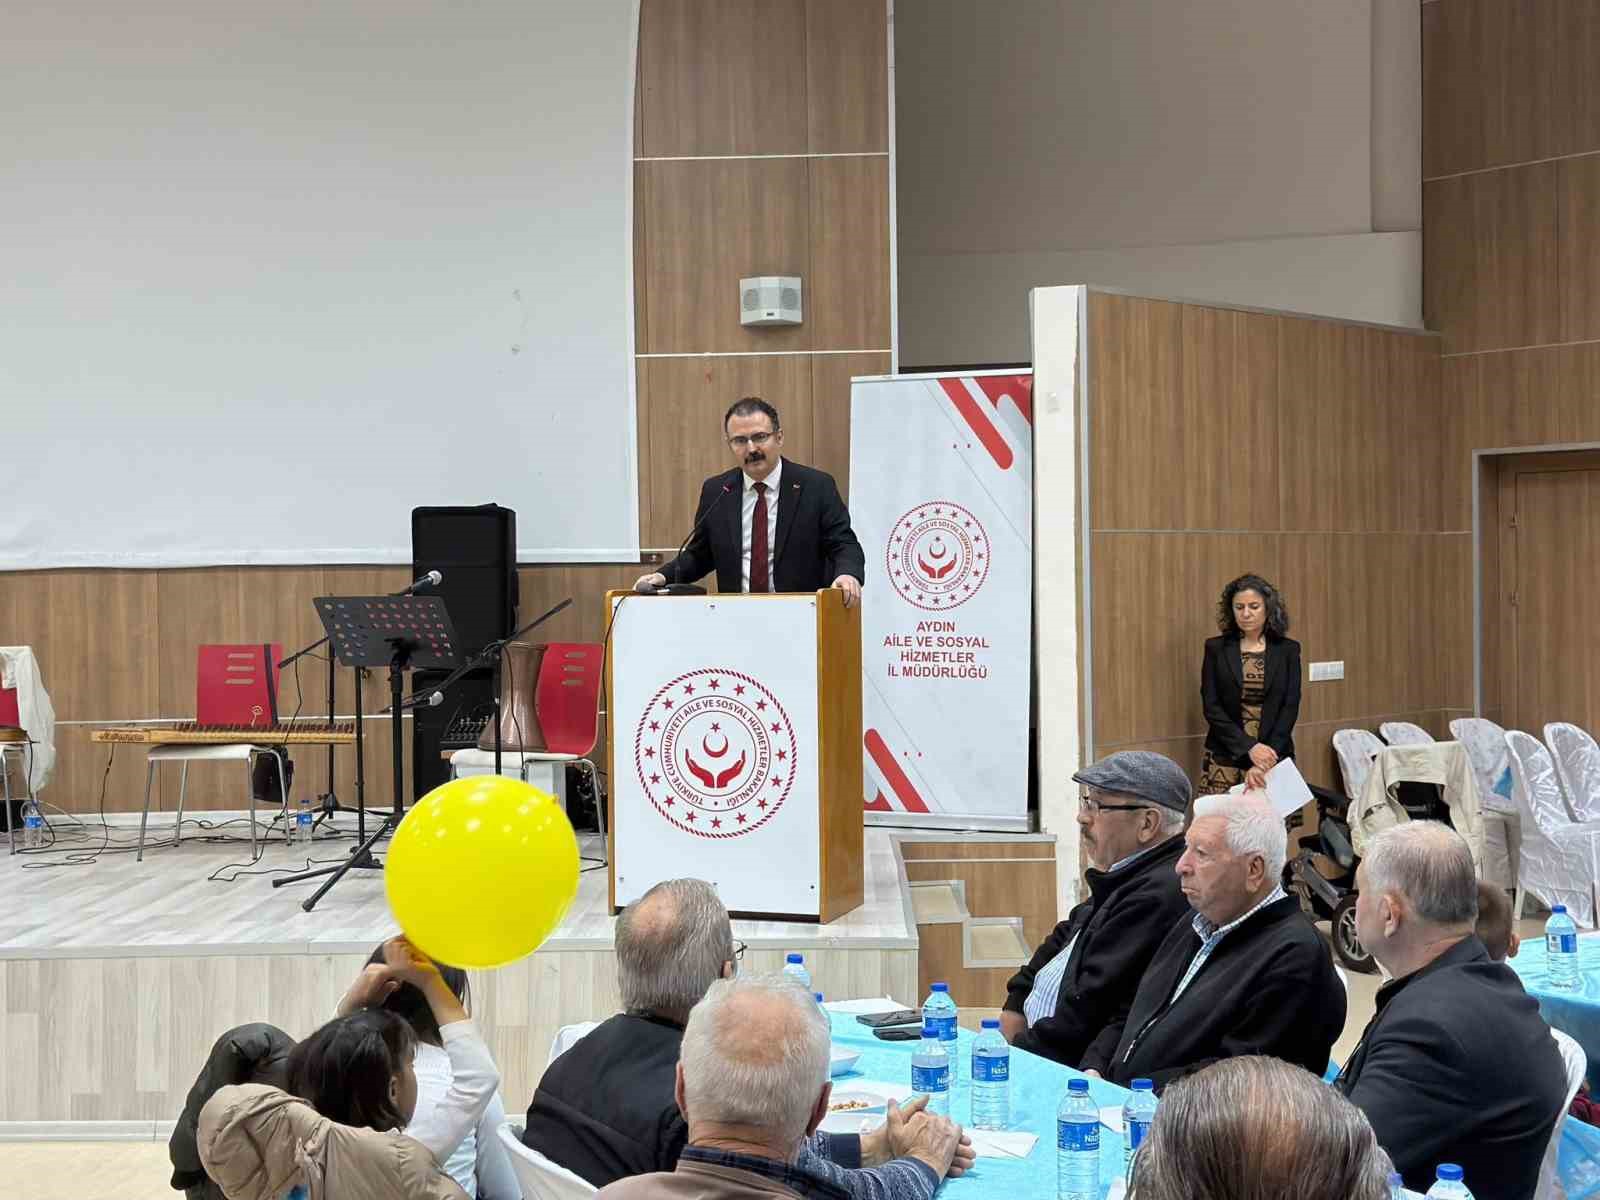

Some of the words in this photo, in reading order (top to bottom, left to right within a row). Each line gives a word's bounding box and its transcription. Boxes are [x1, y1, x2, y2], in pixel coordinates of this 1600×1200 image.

[916, 621, 956, 633] AYDIN
[883, 633, 913, 647] AİLE
[916, 636, 933, 647] VE
[936, 636, 990, 648] SOSYAL
[900, 649, 974, 663] HİZMETLER
[888, 663, 898, 677] İL
[902, 664, 987, 679] MÜDÜRLÜĞÜ
[684, 701, 702, 717] AİLE
[702, 699, 715, 708] VE
[716, 699, 748, 719] SOSYAL
[747, 715, 768, 769] HİZMETLER
